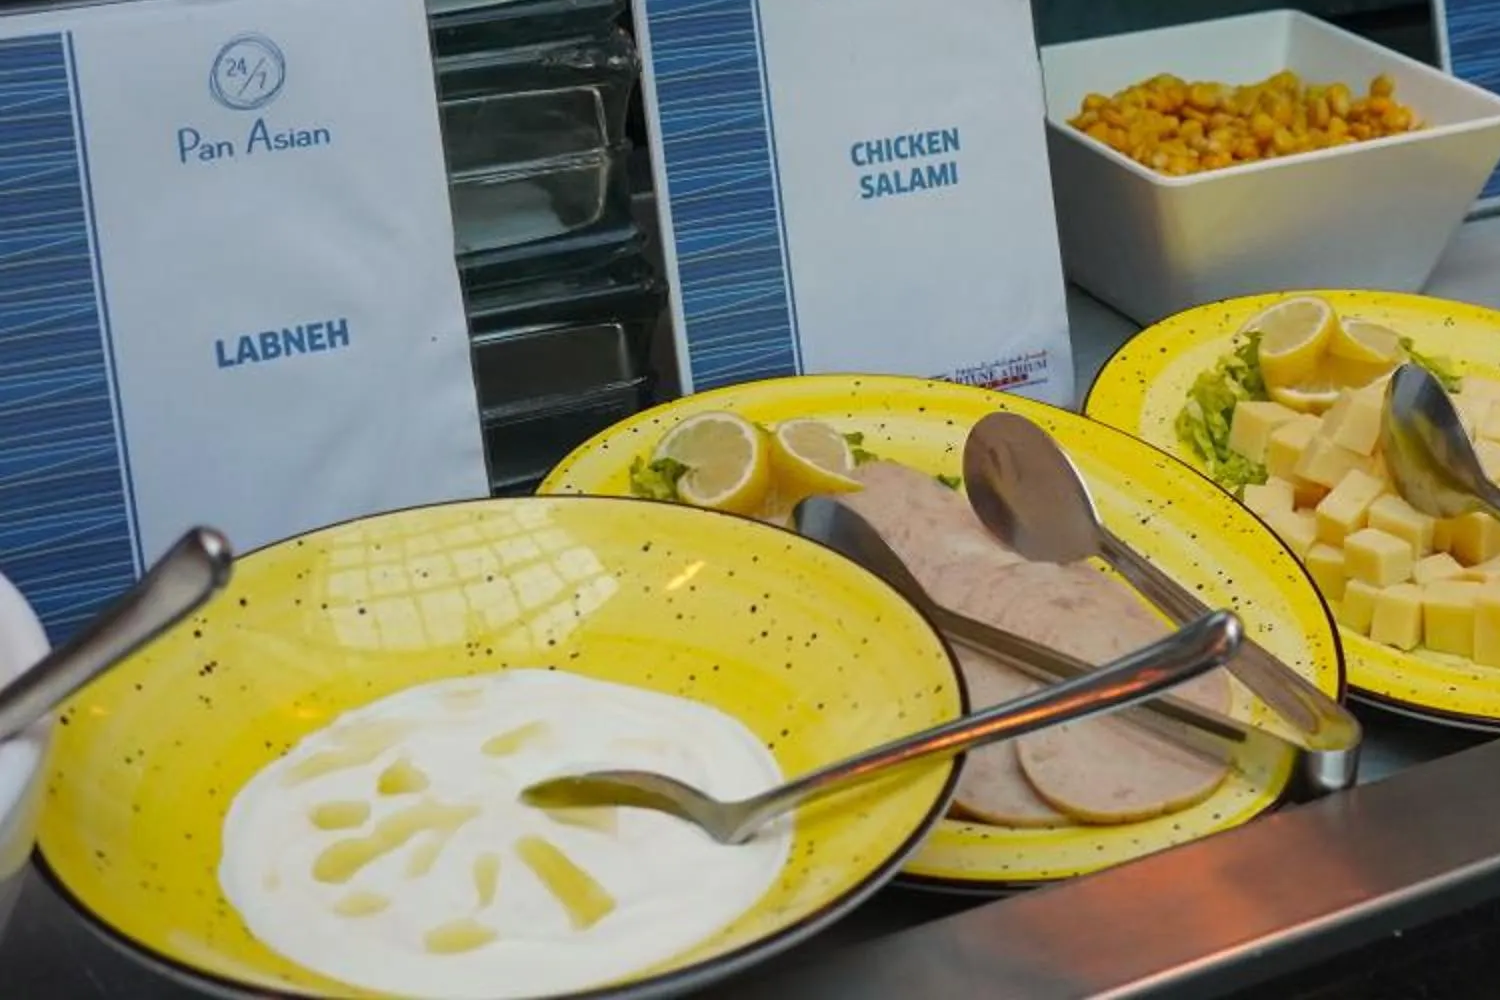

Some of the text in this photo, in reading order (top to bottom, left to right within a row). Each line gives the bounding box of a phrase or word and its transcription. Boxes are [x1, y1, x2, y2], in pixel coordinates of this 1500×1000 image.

[226, 56, 267, 97] 24/7
[178, 117, 331, 164] Pan Asian
[851, 127, 960, 166] CHICKEN
[860, 161, 958, 199] SALAMI
[215, 318, 350, 368] LABNEH
